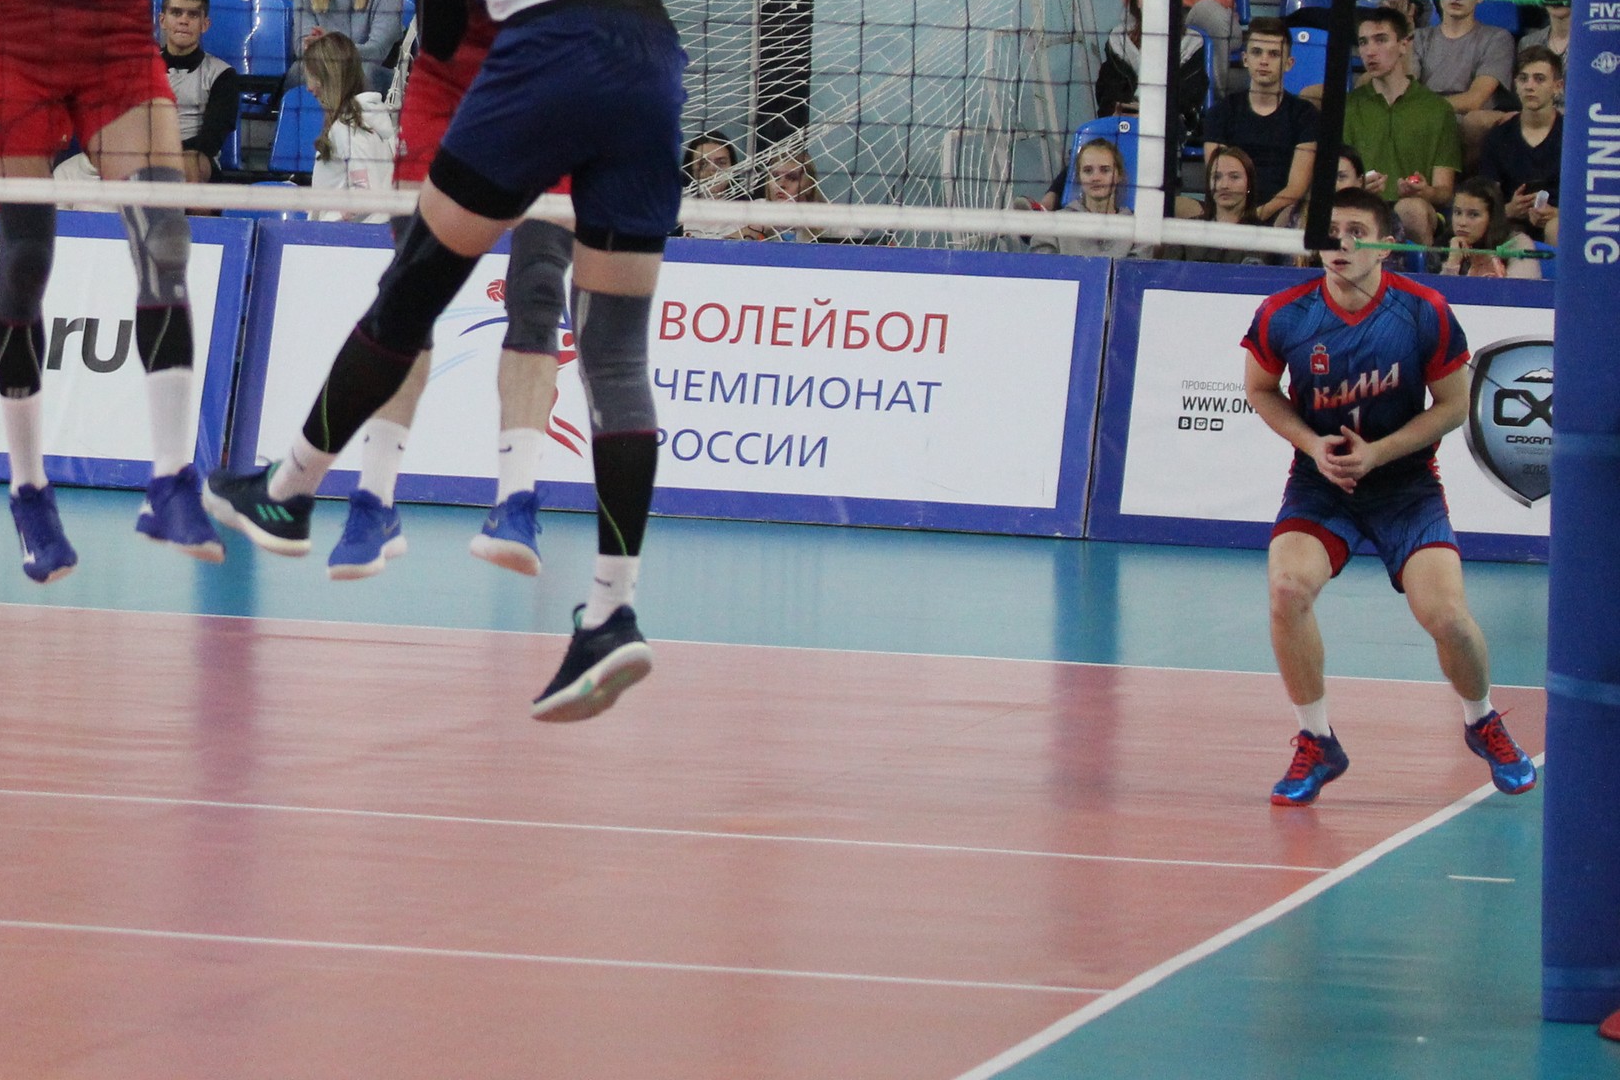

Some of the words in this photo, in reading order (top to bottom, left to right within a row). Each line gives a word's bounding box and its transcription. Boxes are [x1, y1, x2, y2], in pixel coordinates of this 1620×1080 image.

[1589, 2, 1620, 18] FIV
[1584, 102, 1620, 264] JINLING
[659, 298, 949, 354] ВОЛЕЙБОЛ
[653, 368, 942, 413] ЧЕМПИОНАТ
[1181, 380, 1246, 392] ПРОФЕССИОНА
[1182, 396, 1259, 414] WWW.ON
[1313, 362, 1400, 410] КАМА
